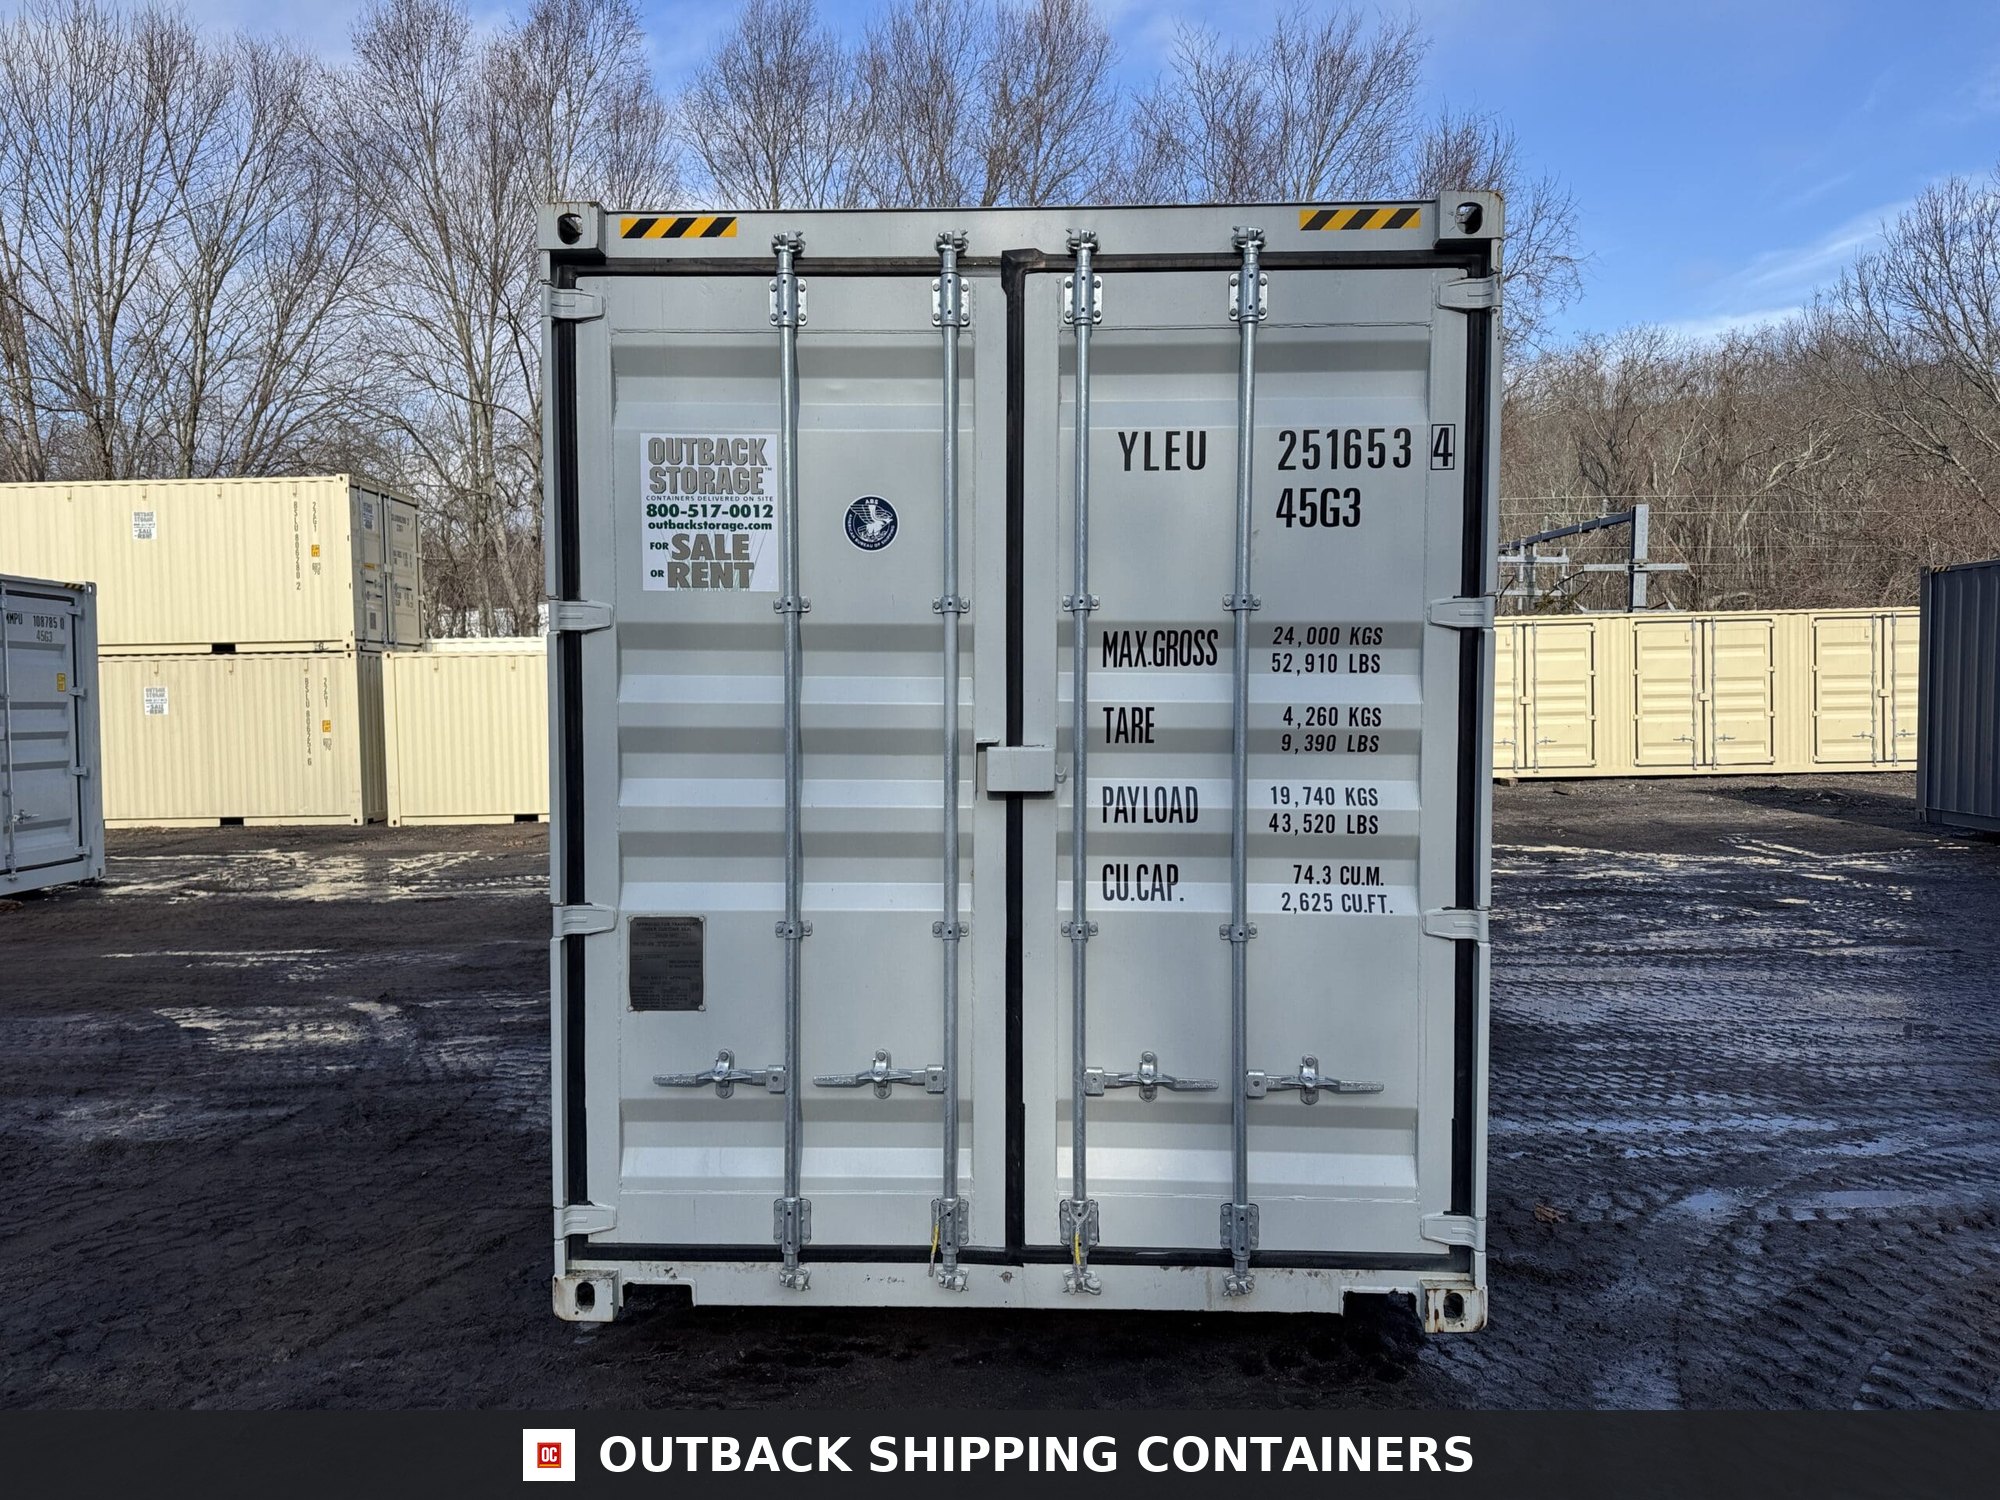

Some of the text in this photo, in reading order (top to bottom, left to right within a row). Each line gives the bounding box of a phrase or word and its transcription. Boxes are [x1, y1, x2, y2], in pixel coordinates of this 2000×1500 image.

[648, 437, 768, 466] OUTBACK
[1117, 426, 1453, 472] YLEU 251653 4
[649, 466, 764, 495] STORAGE
[646, 503, 774, 518] 800-517-0012
[1275, 487, 1361, 529] 45G3
[648, 519, 773, 532] outbackstorage.com
[649, 533, 750, 560] FOR SALE
[854, 538, 873, 548] BUREAU
[650, 562, 755, 588] OR RENT
[33, 615, 58, 629] 108785
[60, 617, 65, 630] 0
[36, 630, 53, 642] 45G3
[1272, 625, 1384, 648] 24,000 KGS
[1102, 629, 1219, 668] MAX.GROSS
[1271, 653, 1381, 675] 52,910 LBS
[1102, 706, 1155, 744] TARE
[1282, 706, 1382, 730] 4,260 KGS
[1281, 734, 1380, 755] 9,390 LBS
[1102, 786, 1199, 824] PAYLOAD
[1270, 787, 1378, 808] 19,740 KGS
[1269, 813, 1379, 836] 43,520 LBS
[1102, 863, 1185, 902] CU.CAP.
[1293, 865, 1385, 887] 74.3 CU.M.
[1281, 893, 1394, 914] 2,625 CU.FT.
